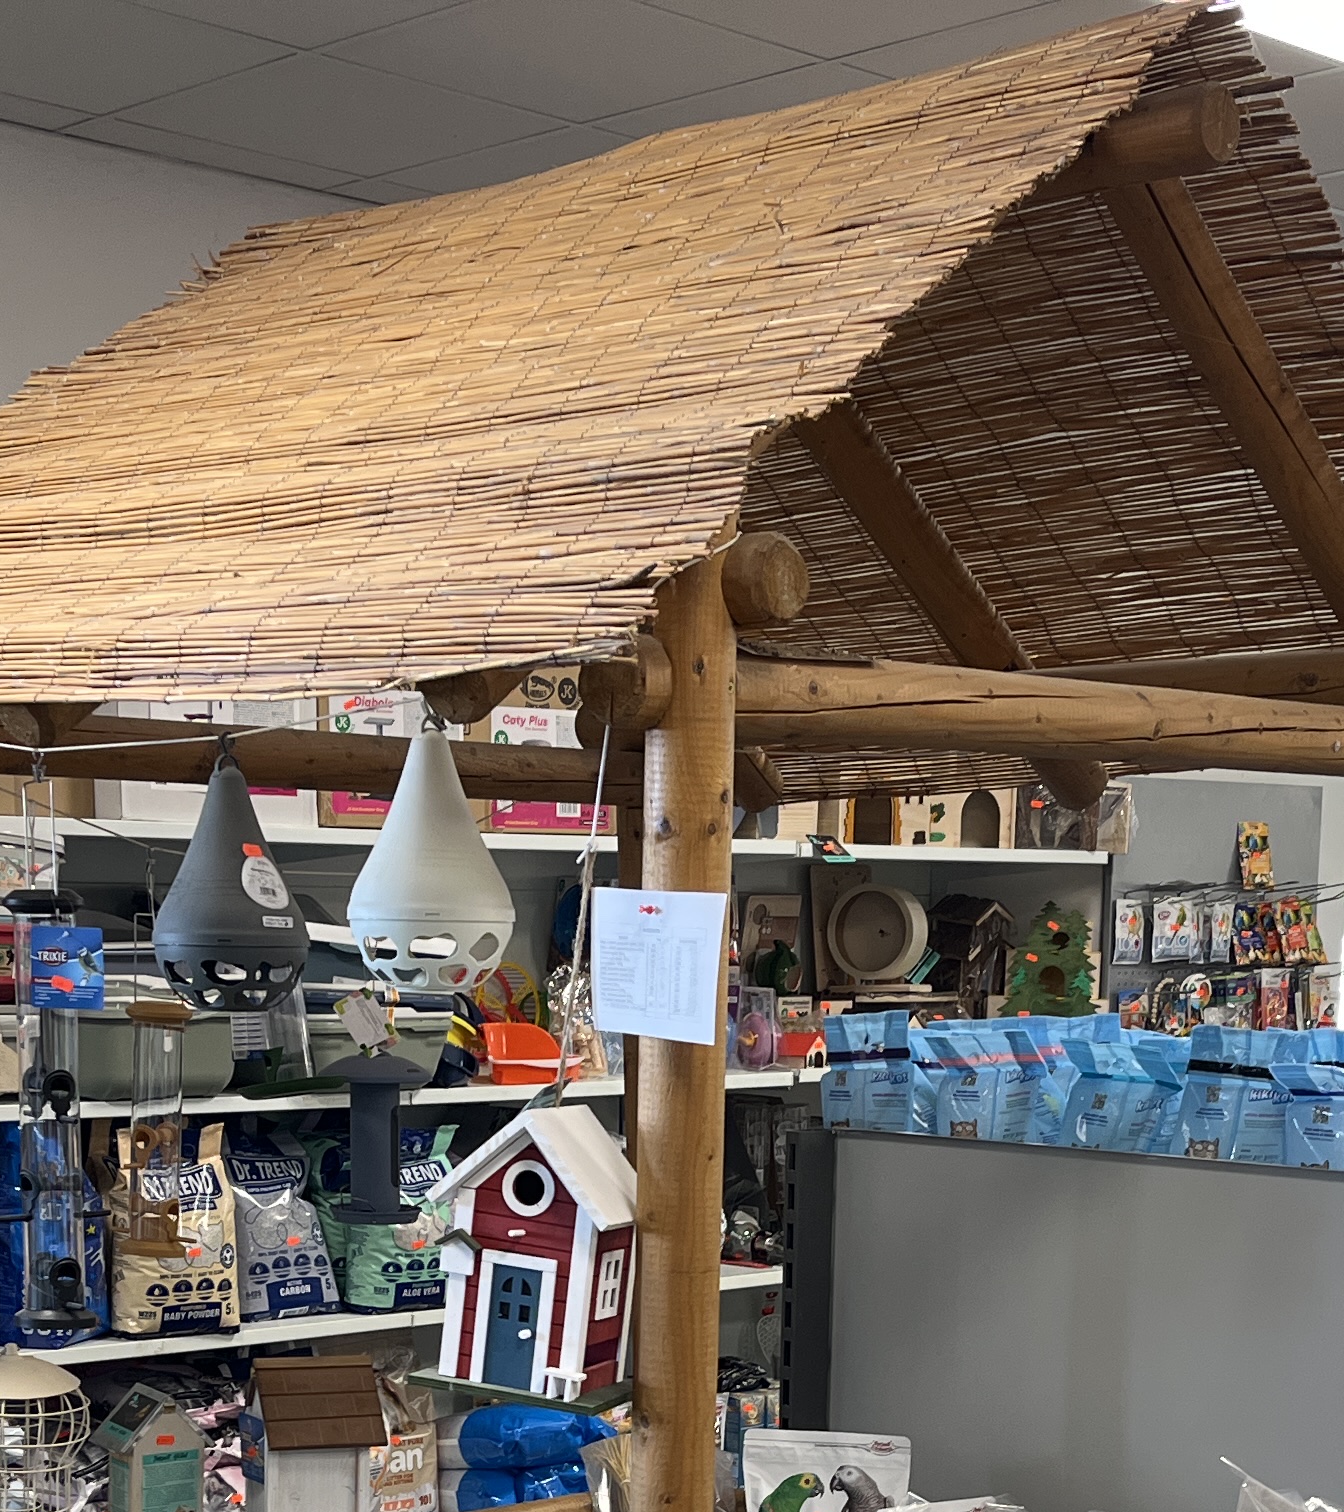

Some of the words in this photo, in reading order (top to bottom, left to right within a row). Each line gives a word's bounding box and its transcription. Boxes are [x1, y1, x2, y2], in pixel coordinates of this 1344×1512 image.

[528, 714, 549, 727] Plus
[38, 951, 68, 963] TRIXIE
[232, 1159, 256, 1181] Dr.
[259, 1159, 304, 1180] TREND
[279, 1284, 311, 1297] CARBON
[402, 1287, 420, 1298] ALOE
[421, 1285, 442, 1297] VERA
[164, 1310, 187, 1322] BABY
[188, 1306, 221, 1321] POWDER
